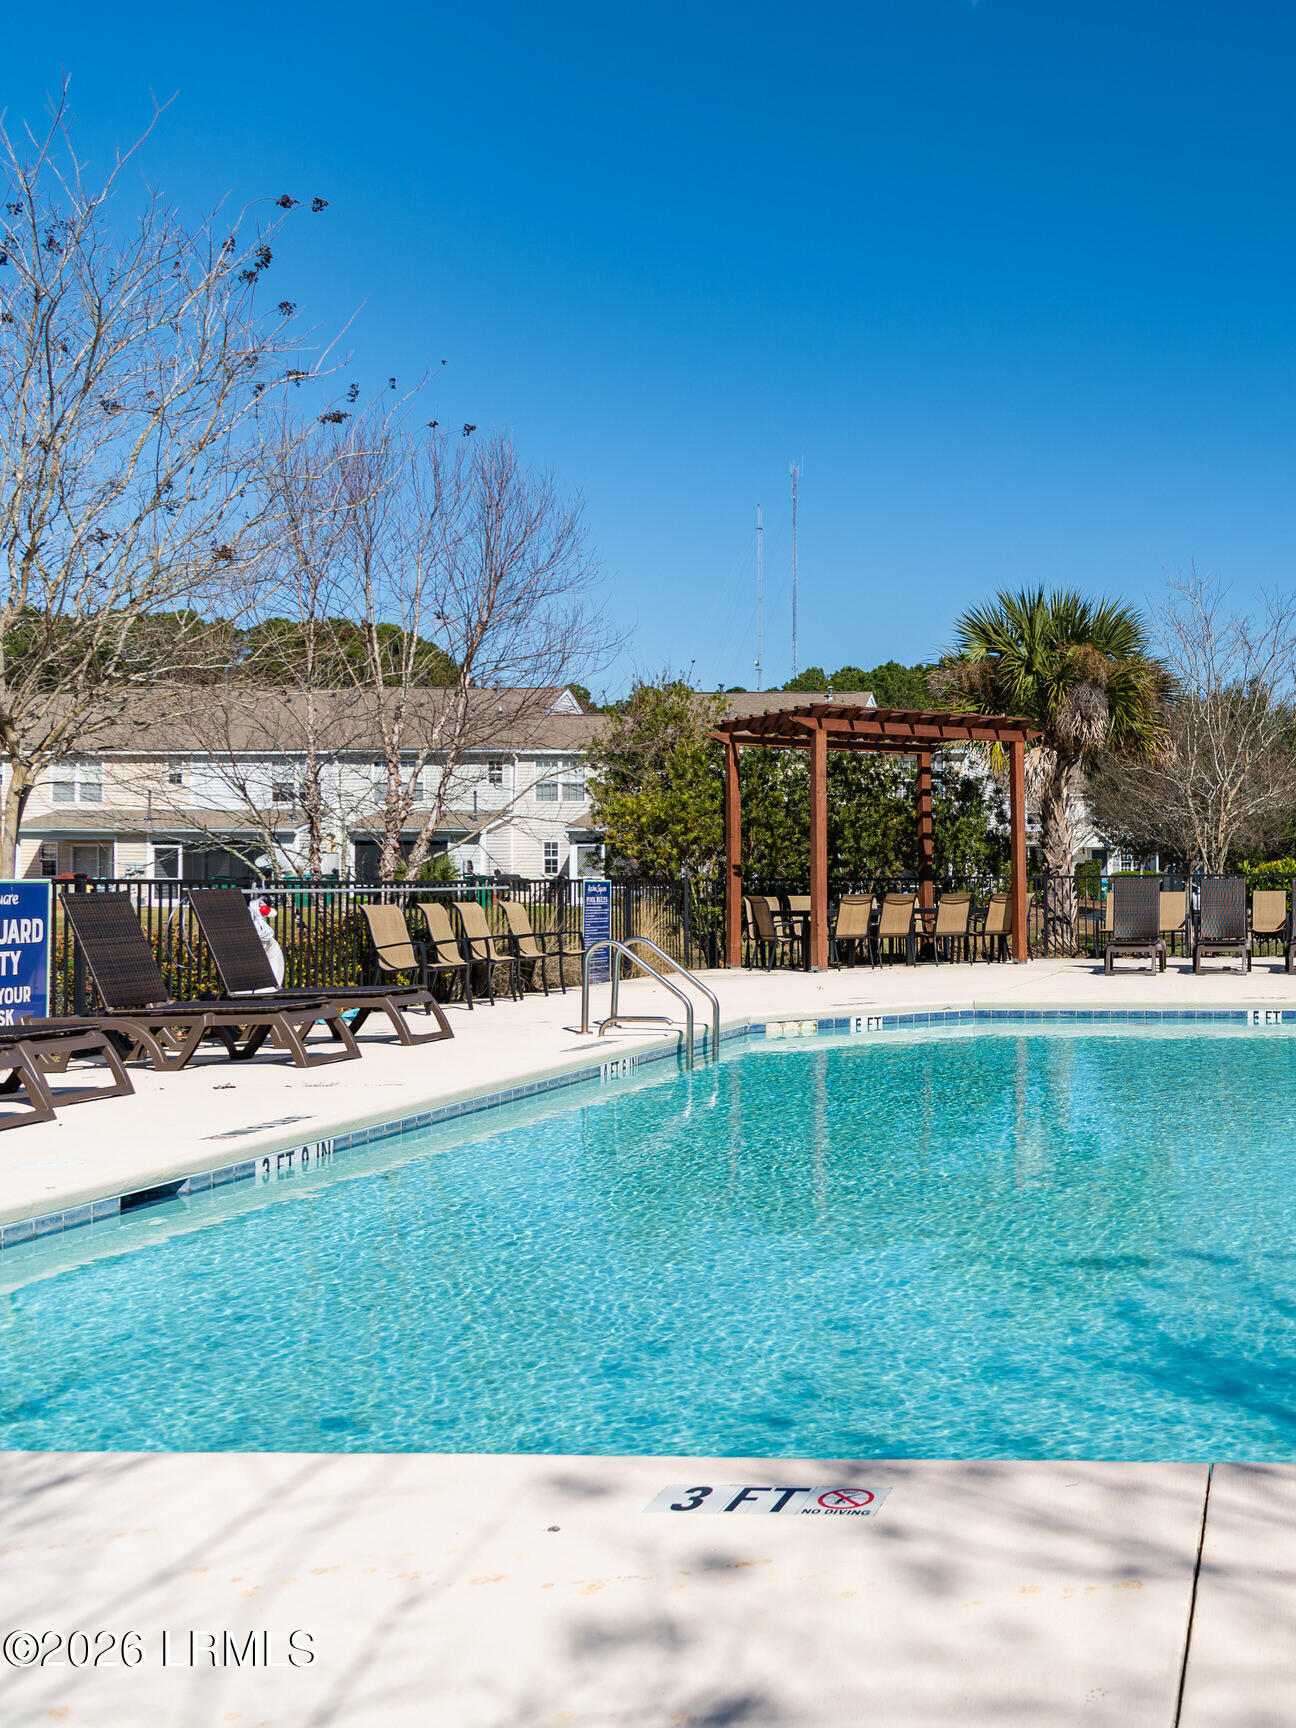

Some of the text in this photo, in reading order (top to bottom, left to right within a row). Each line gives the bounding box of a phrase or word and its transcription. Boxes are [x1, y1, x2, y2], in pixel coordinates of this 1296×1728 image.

[0, 918, 44, 945] UARD
[0, 950, 22, 976] TY
[0, 985, 31, 1005] YOUR
[0, 1008, 15, 1026] SK
[277, 1150, 295, 1170] FT
[670, 1486, 812, 1513] 3 FT
[824, 1508, 871, 1516] DIVING
